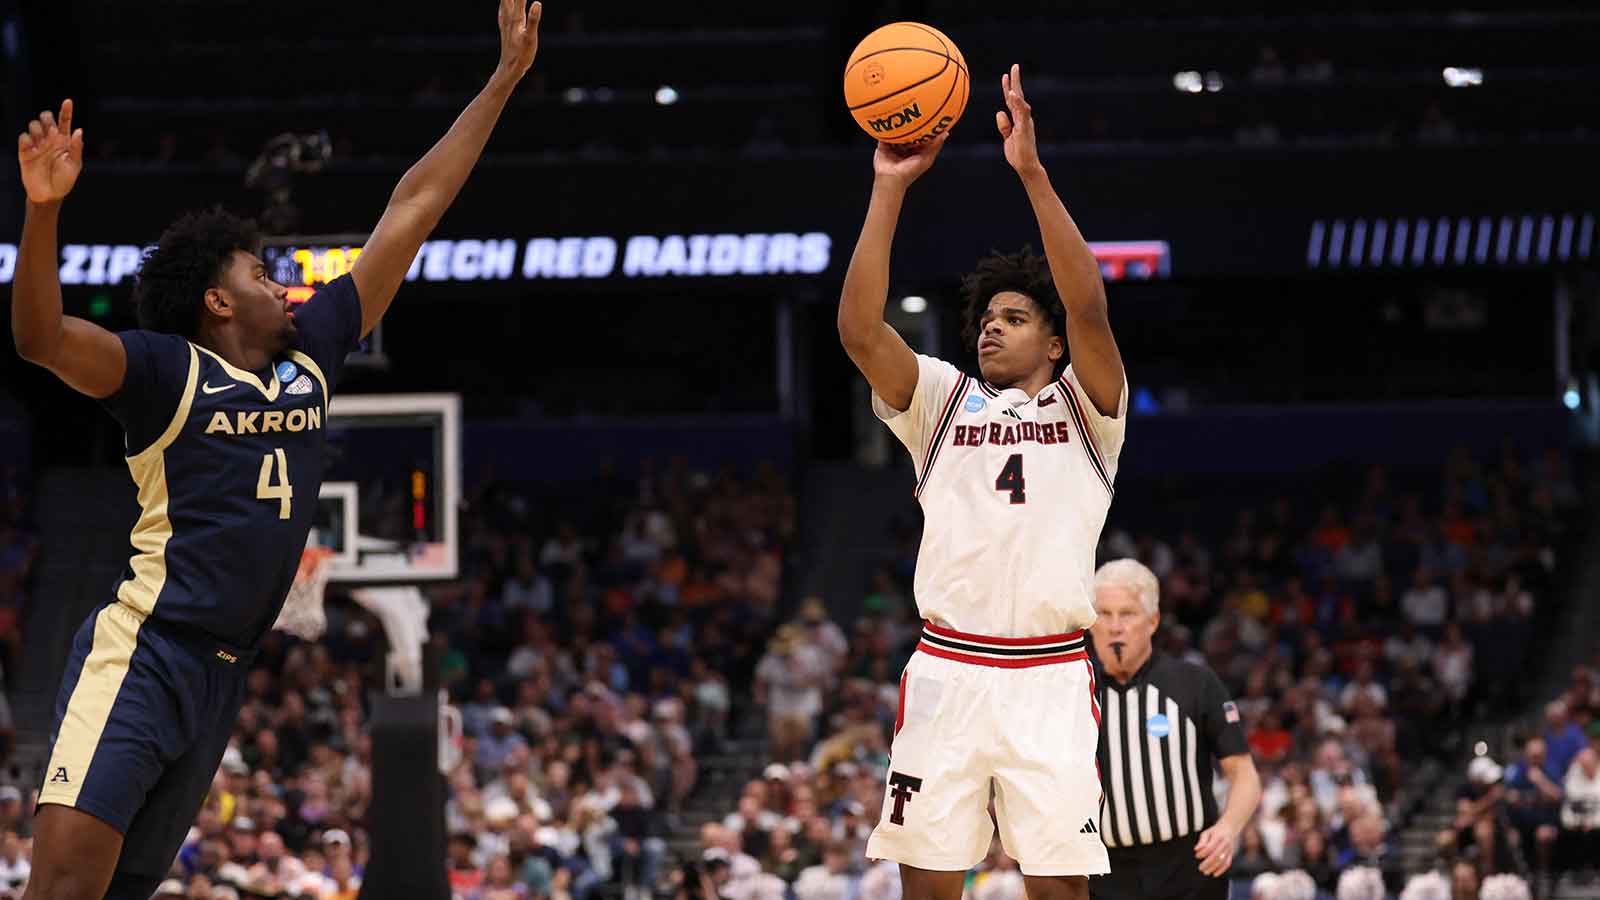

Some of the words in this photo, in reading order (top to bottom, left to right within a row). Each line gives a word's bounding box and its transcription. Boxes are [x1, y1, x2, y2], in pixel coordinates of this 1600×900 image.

[867, 103, 922, 133] NCAA
[59, 244, 160, 284] ZIP
[523, 237, 616, 278] RED
[623, 233, 831, 276] RAIDERS
[205, 406, 321, 435] AKRON
[953, 424, 987, 447] RED
[988, 421, 1069, 446] RAIDERS
[256, 448, 293, 520] 4
[995, 453, 1026, 505] 4
[216, 650, 238, 663] ZIPS
[50, 767, 70, 782] A
